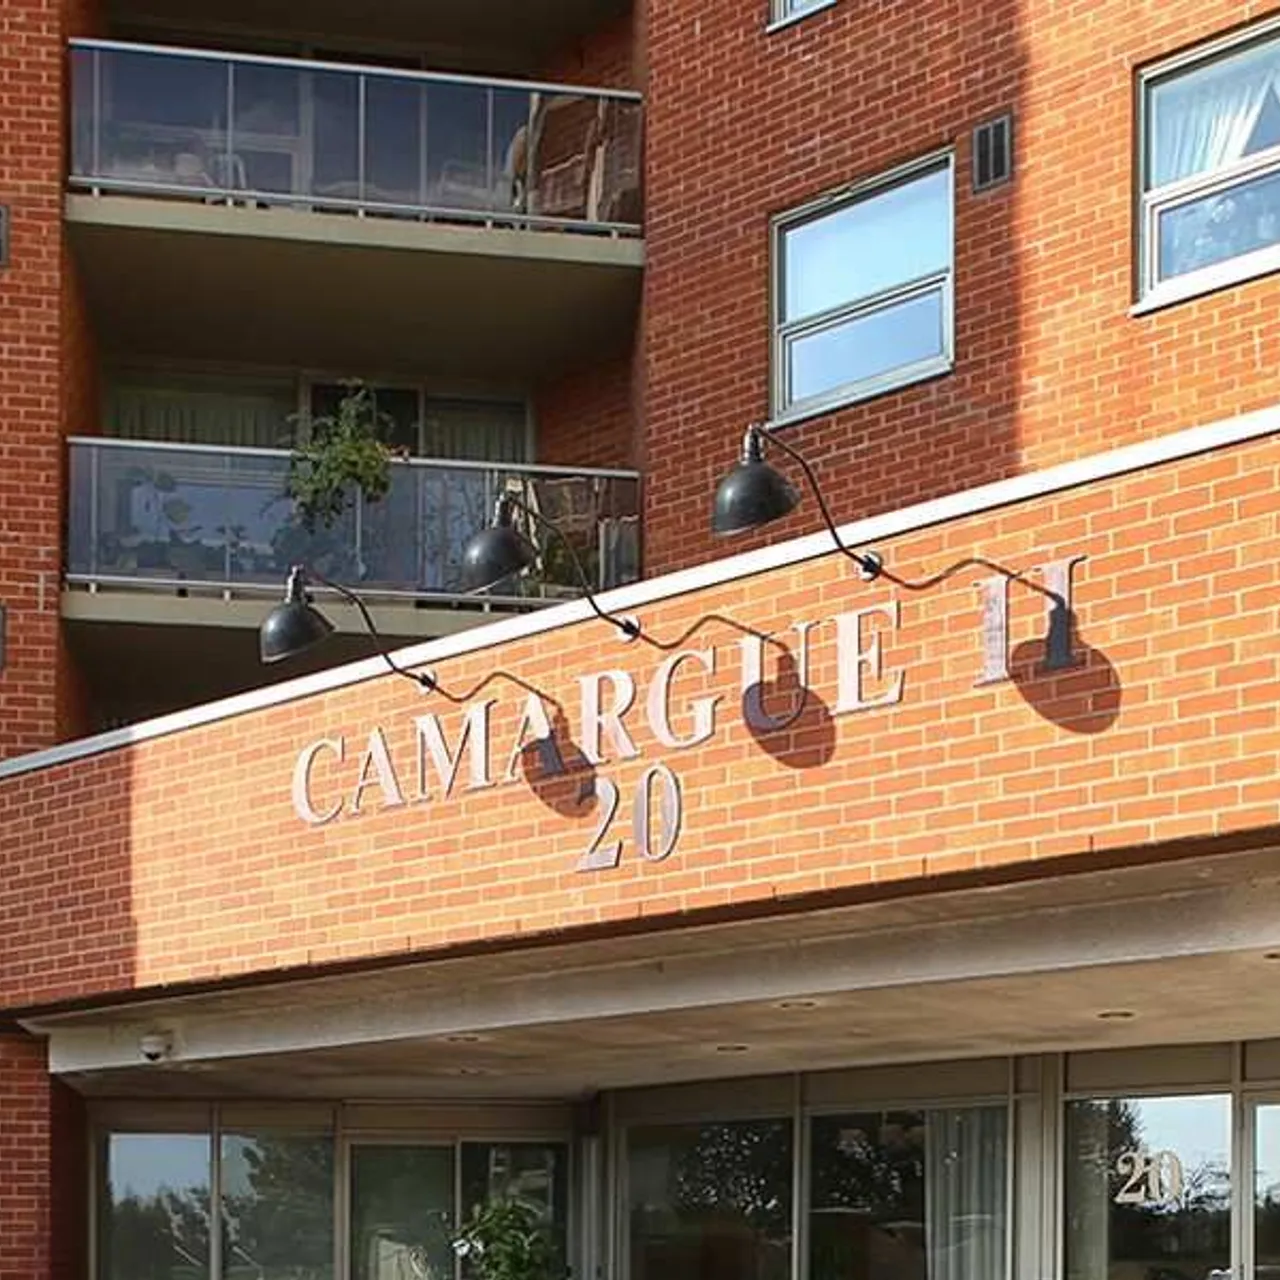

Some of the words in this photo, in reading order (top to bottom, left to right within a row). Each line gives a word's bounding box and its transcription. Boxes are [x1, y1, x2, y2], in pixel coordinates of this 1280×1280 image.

[292, 601, 906, 826] CAMARGUE
[973, 556, 1088, 688] II
[576, 763, 682, 873] 20
